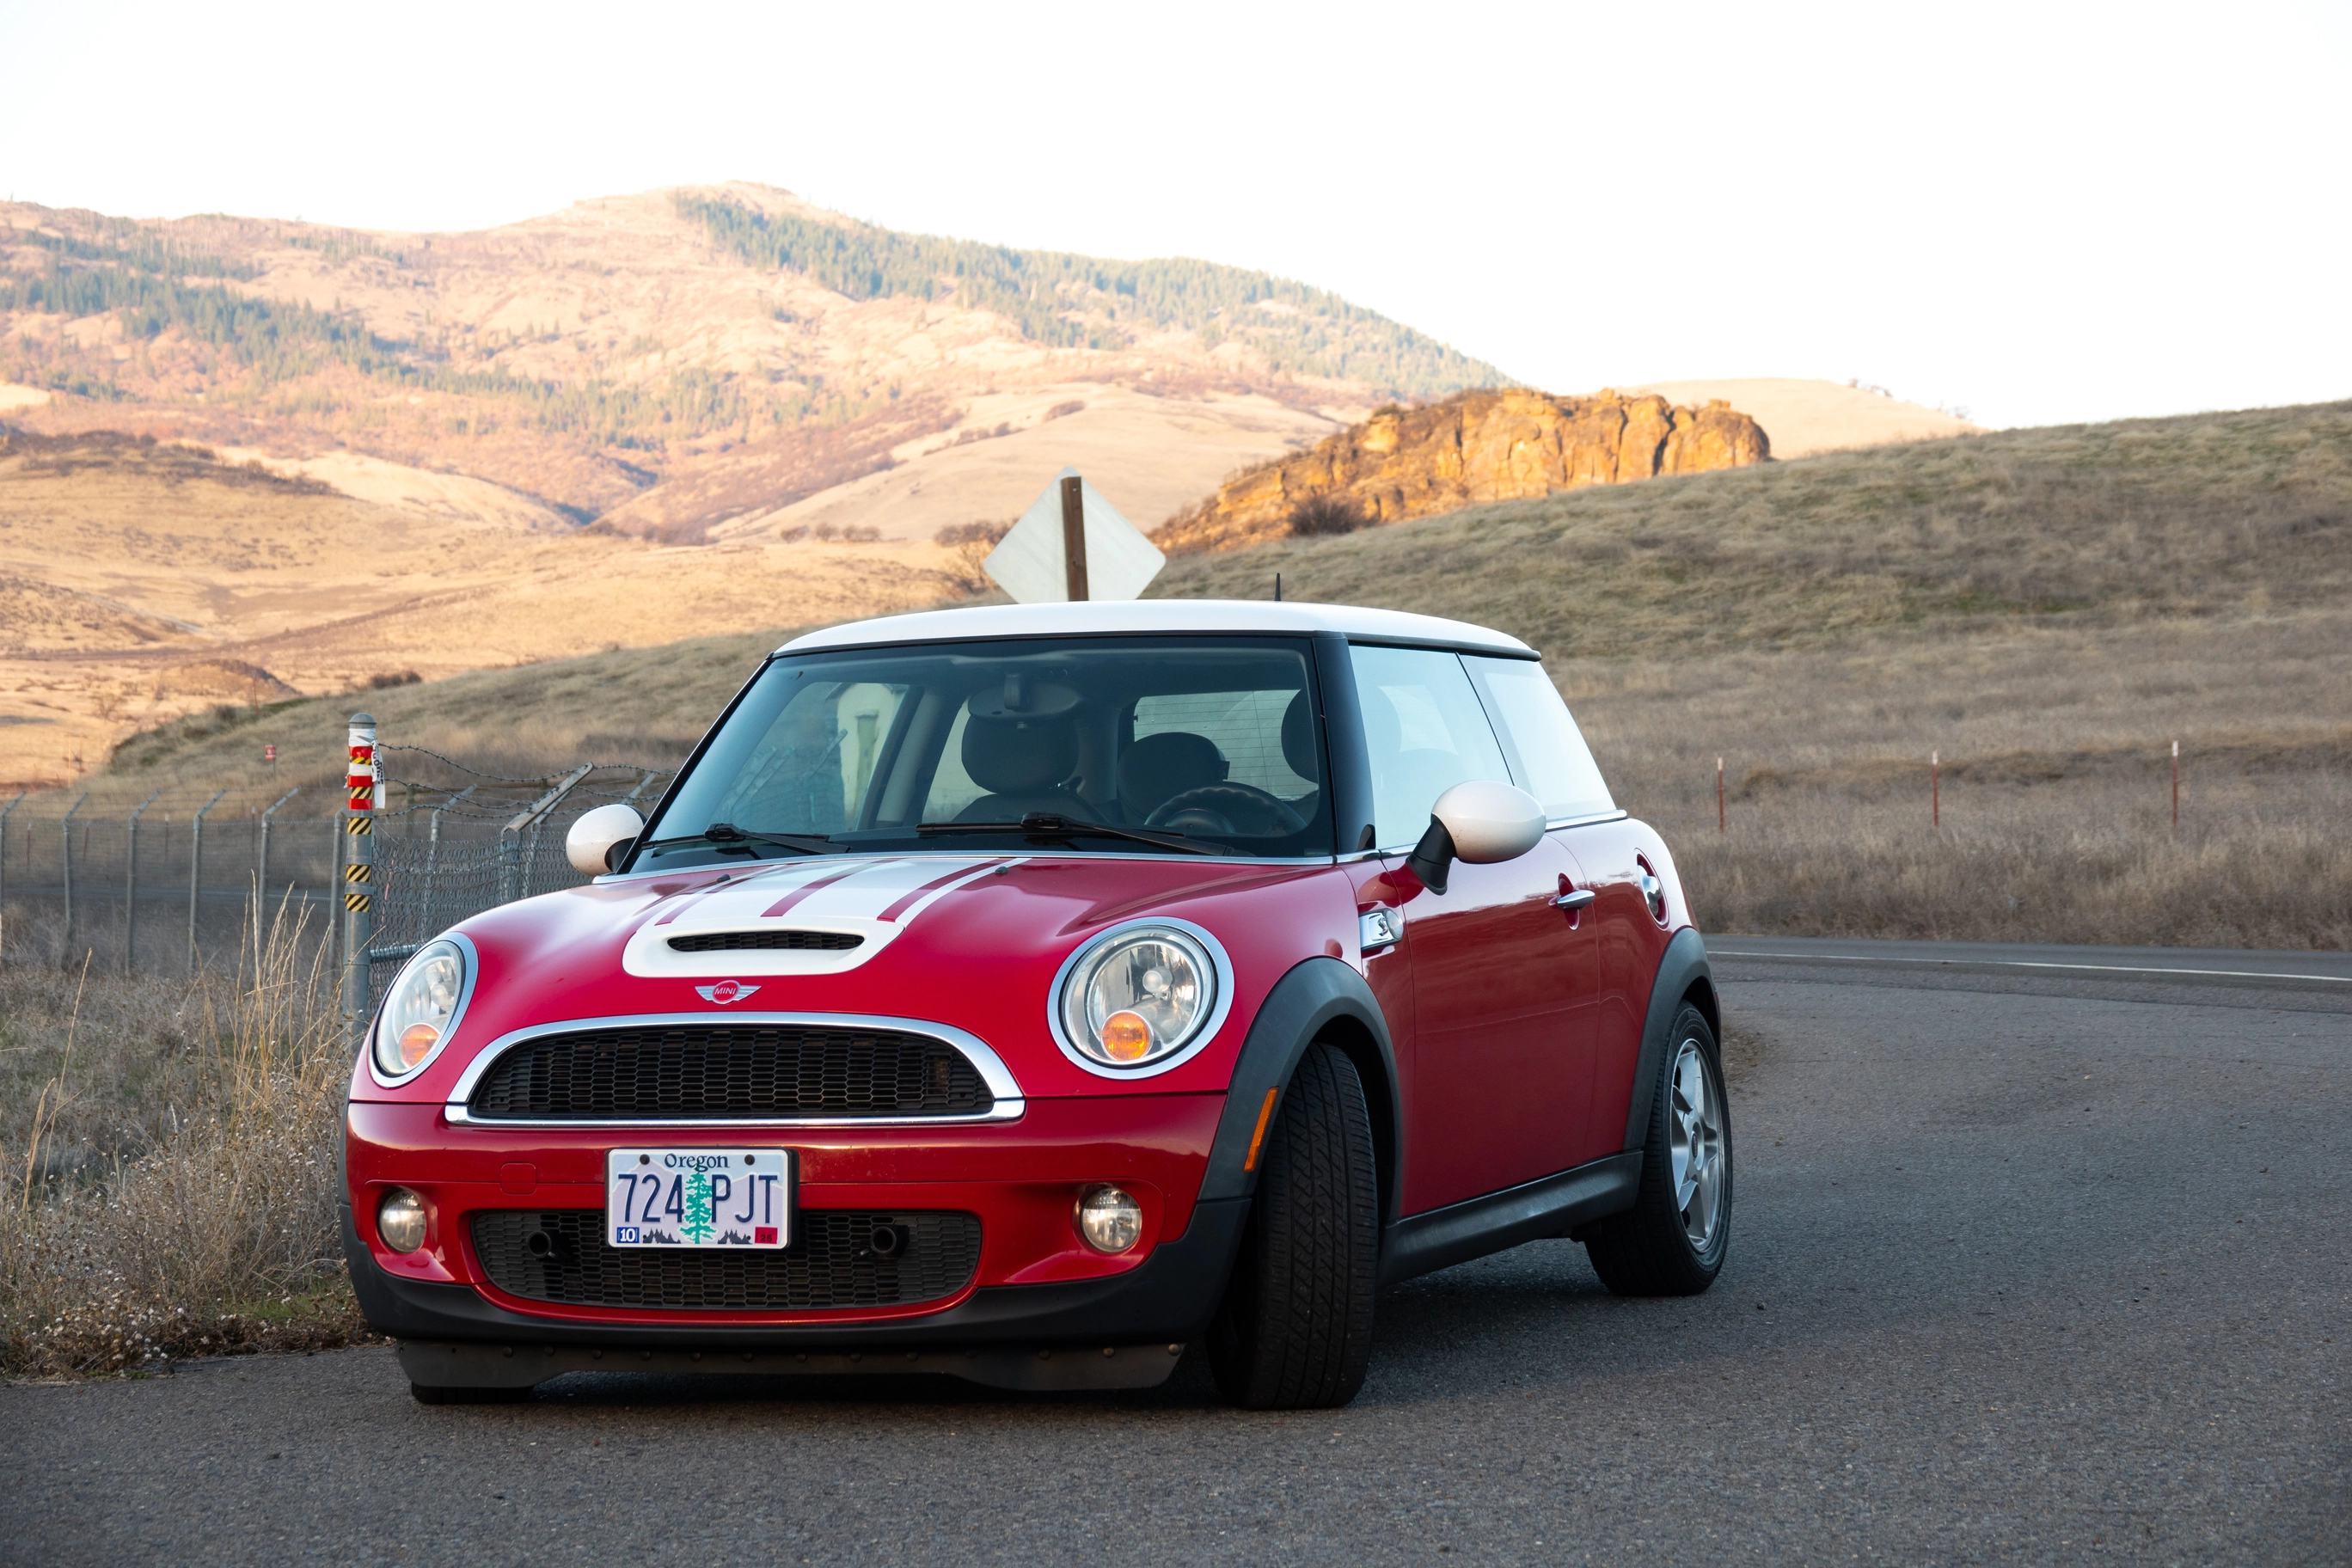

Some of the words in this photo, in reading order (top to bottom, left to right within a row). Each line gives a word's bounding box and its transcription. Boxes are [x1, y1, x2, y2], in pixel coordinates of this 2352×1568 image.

[665, 1153, 731, 1173] Oregon
[618, 1174, 684, 1222] 724
[711, 1174, 778, 1223] PJT
[620, 1228, 636, 1242] 10
[760, 1234, 773, 1243] 25
